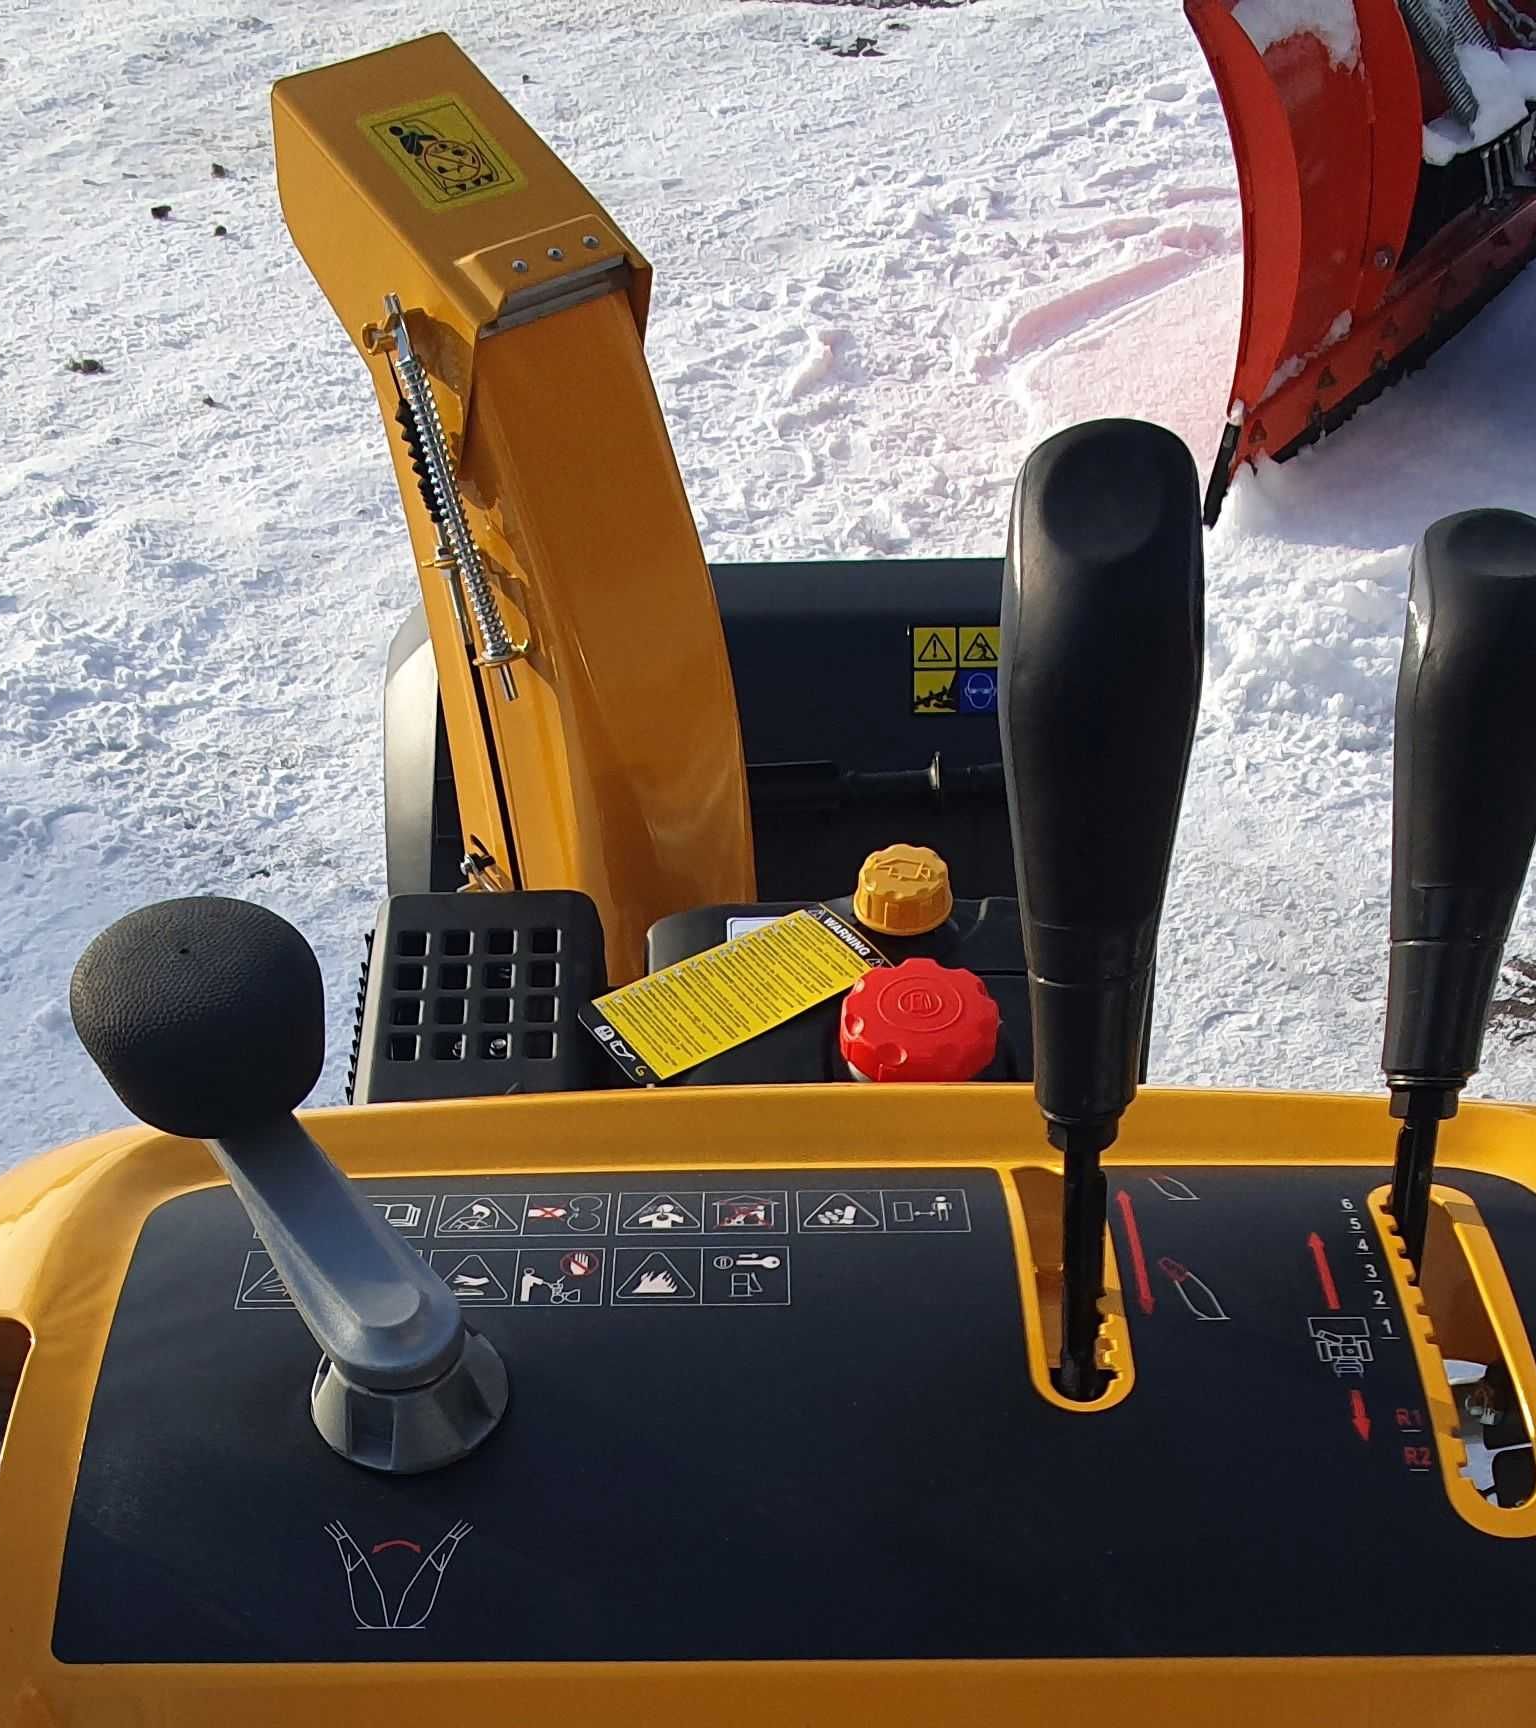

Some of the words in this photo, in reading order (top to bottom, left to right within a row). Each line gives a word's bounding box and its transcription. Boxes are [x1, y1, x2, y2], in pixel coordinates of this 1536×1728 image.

[824, 916, 871, 957] WARNING
[1341, 1198, 1354, 1210] 6
[1349, 1217, 1362, 1230] 5
[1357, 1238, 1369, 1251] 4
[1364, 1263, 1378, 1278] 3
[1372, 1289, 1386, 1305] 2
[1382, 1318, 1393, 1335] 1
[1395, 1408, 1422, 1426] R1
[1404, 1446, 1432, 1467] R2
